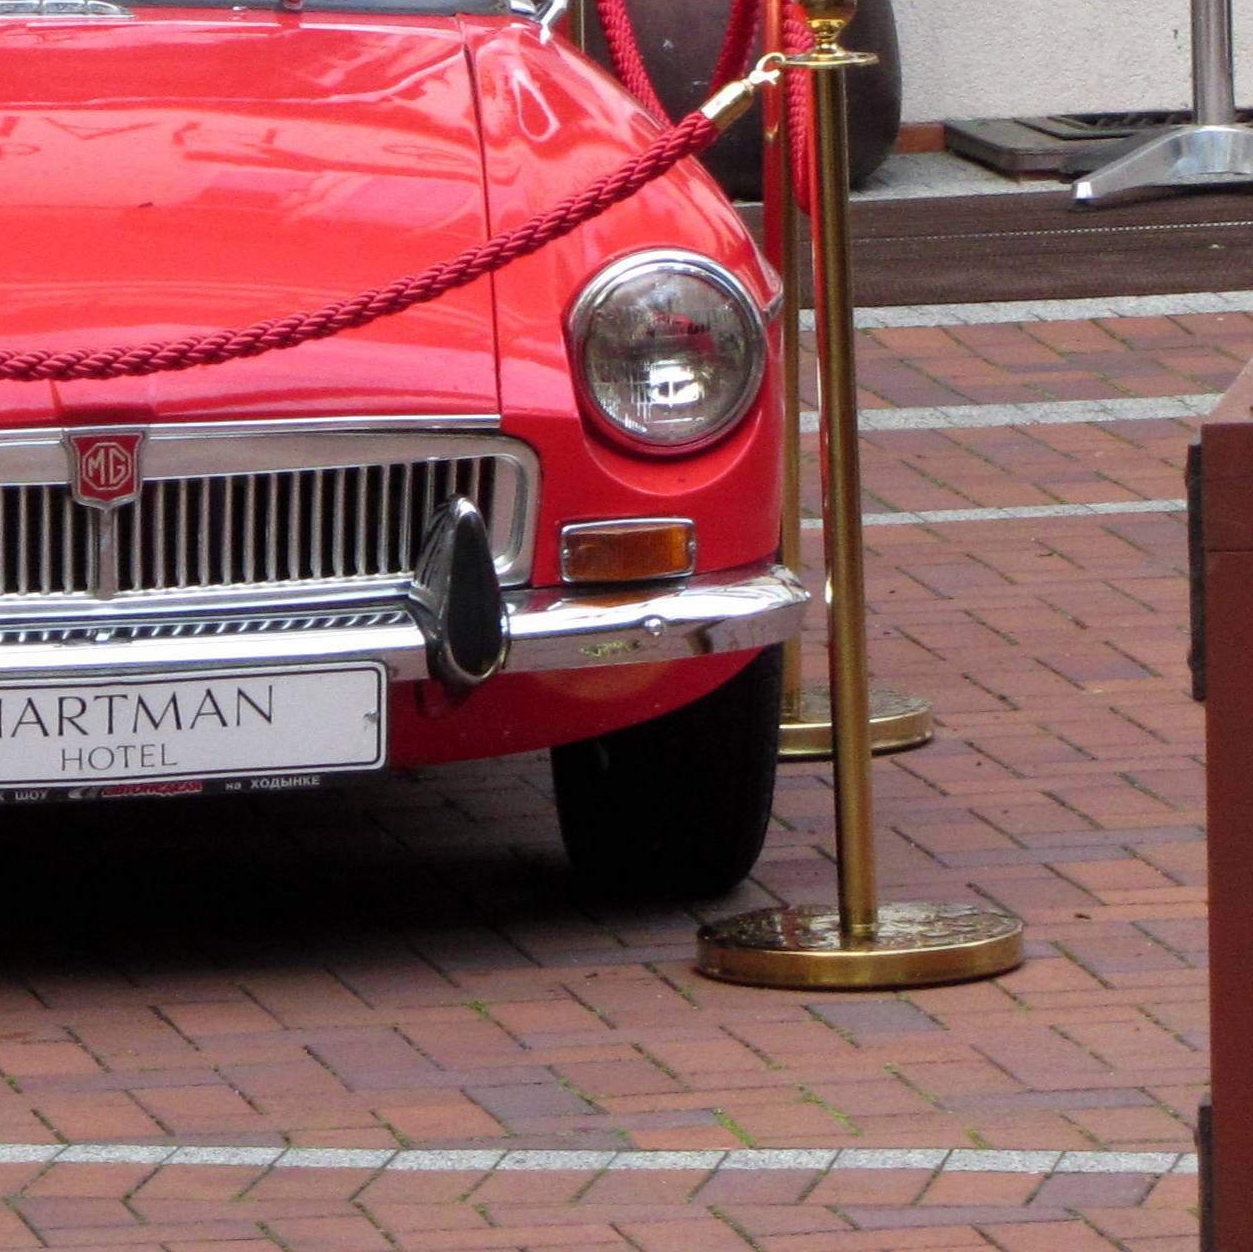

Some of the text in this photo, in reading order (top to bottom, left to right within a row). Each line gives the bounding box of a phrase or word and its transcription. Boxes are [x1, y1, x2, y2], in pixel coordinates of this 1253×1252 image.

[87, 447, 126, 486] MG
[60, 743, 179, 773] HOTEL
[14, 789, 48, 801] ШОУ
[225, 782, 242, 791] на
[250, 775, 321, 790] ХОДЫНКЕ
